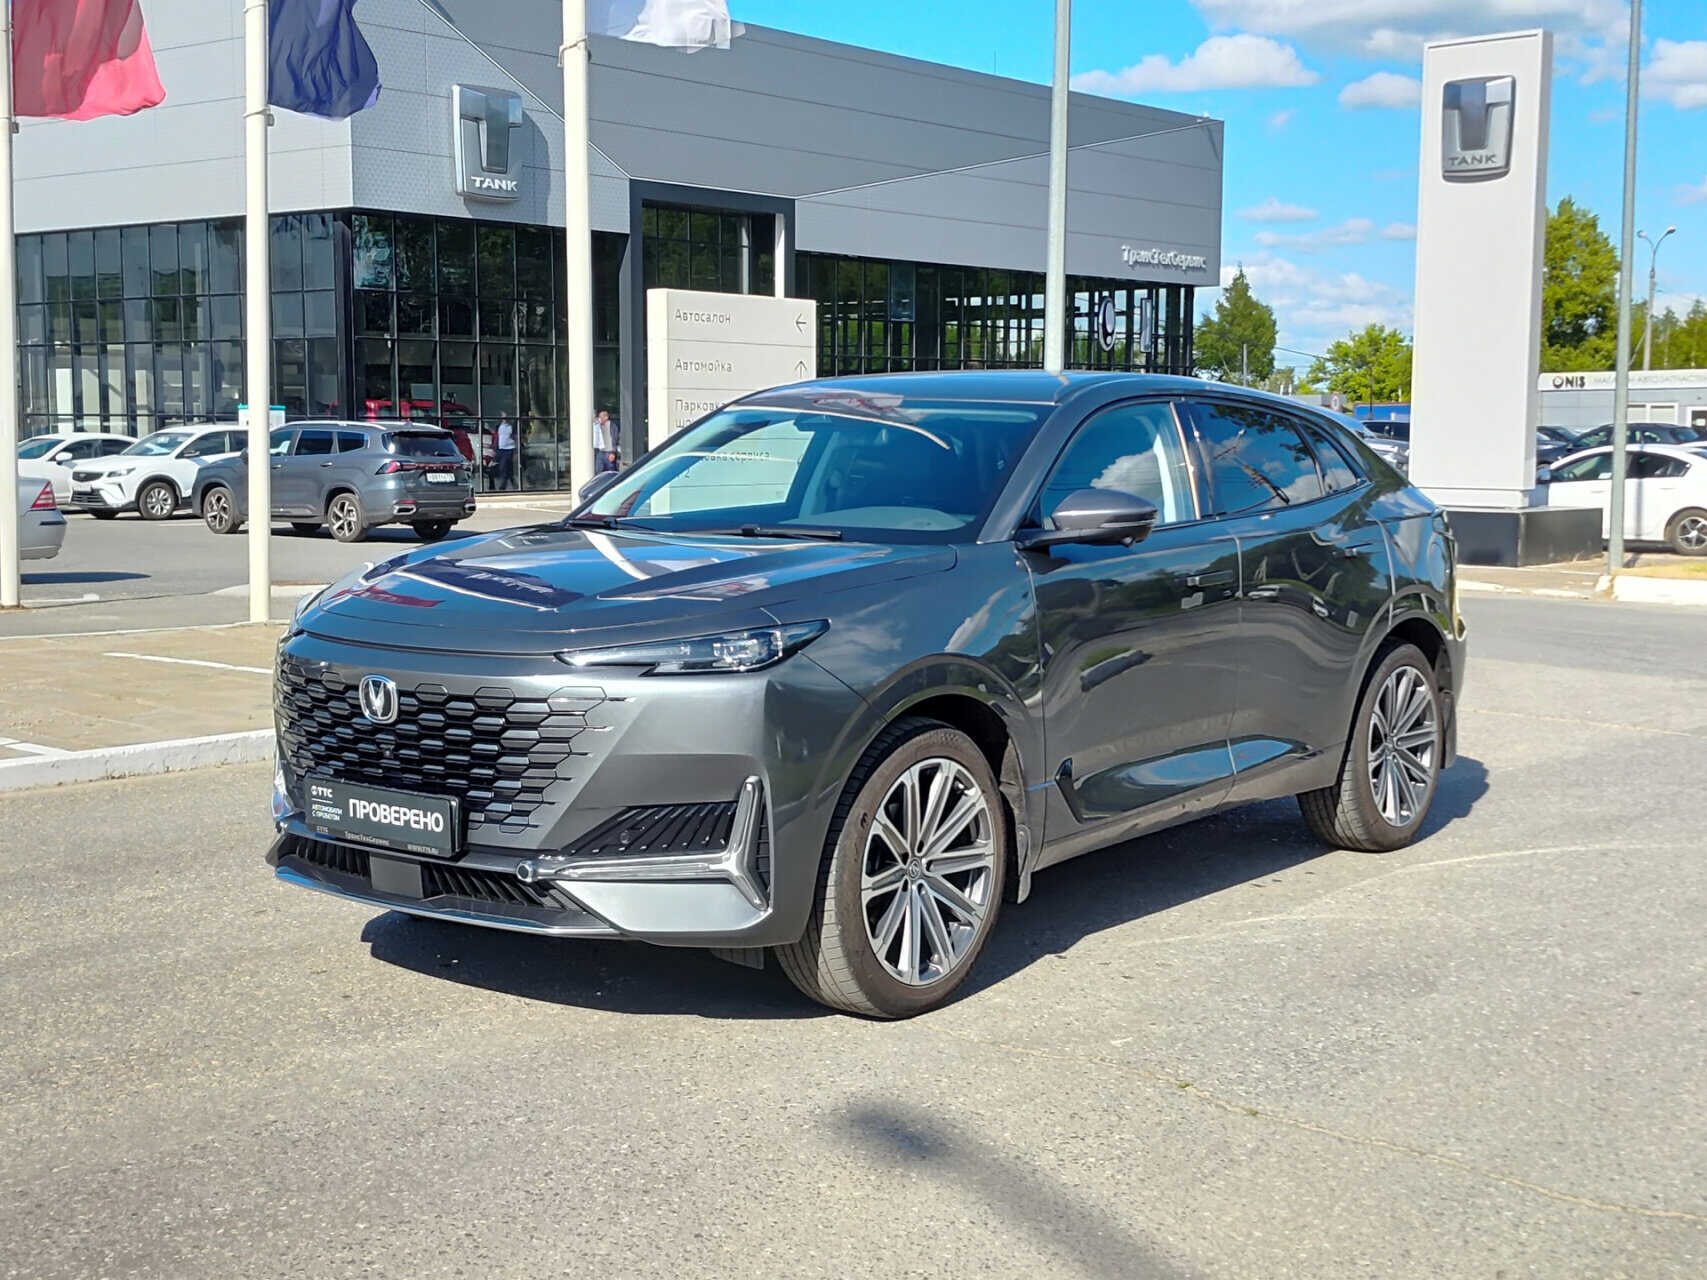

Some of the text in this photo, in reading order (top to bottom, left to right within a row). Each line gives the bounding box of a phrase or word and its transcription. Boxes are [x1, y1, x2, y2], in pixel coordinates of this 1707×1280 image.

[1448, 154, 1497, 166] TANK
[471, 176, 518, 191] TANK
[675, 309, 731, 323] Автосалон
[675, 358, 732, 372] Автомойка
[349, 798, 444, 832] ПРОВЕРЕНО
